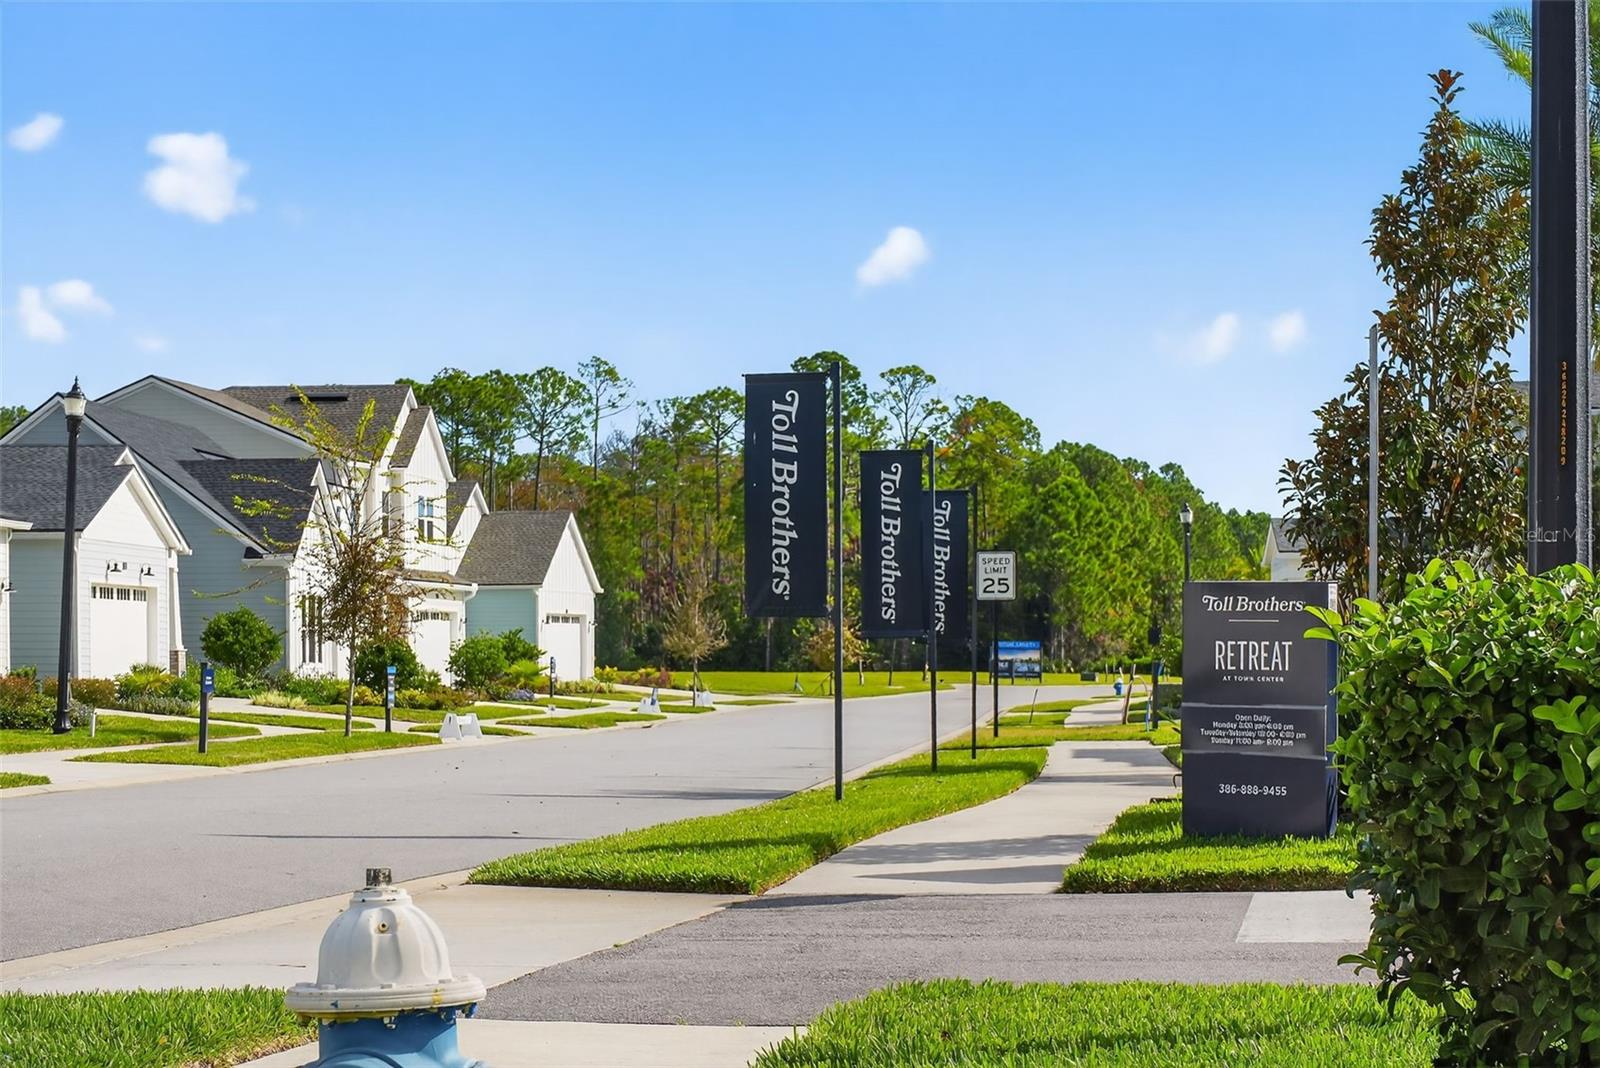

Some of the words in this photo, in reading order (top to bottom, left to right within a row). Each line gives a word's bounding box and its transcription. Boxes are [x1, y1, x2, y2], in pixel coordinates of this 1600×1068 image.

[771, 390, 799, 454] Toll
[880, 462, 902, 512] Toll
[771, 458, 799, 596] Brothers
[933, 500, 951, 541] Toll
[880, 515, 902, 621] Brothers
[982, 557, 1010, 565] SPEED
[984, 566, 1007, 574] LIMIT
[934, 544, 951, 632] Brothers
[983, 578, 1010, 593] 25
[1202, 595, 1233, 611] Toll
[1236, 596, 1304, 612] Brothers
[1215, 640, 1292, 671] RETREAT
[1212, 721, 1237, 729] Monday
[1211, 737, 1234, 745] Sunday
[1219, 783, 1287, 796] 386-888-9455
